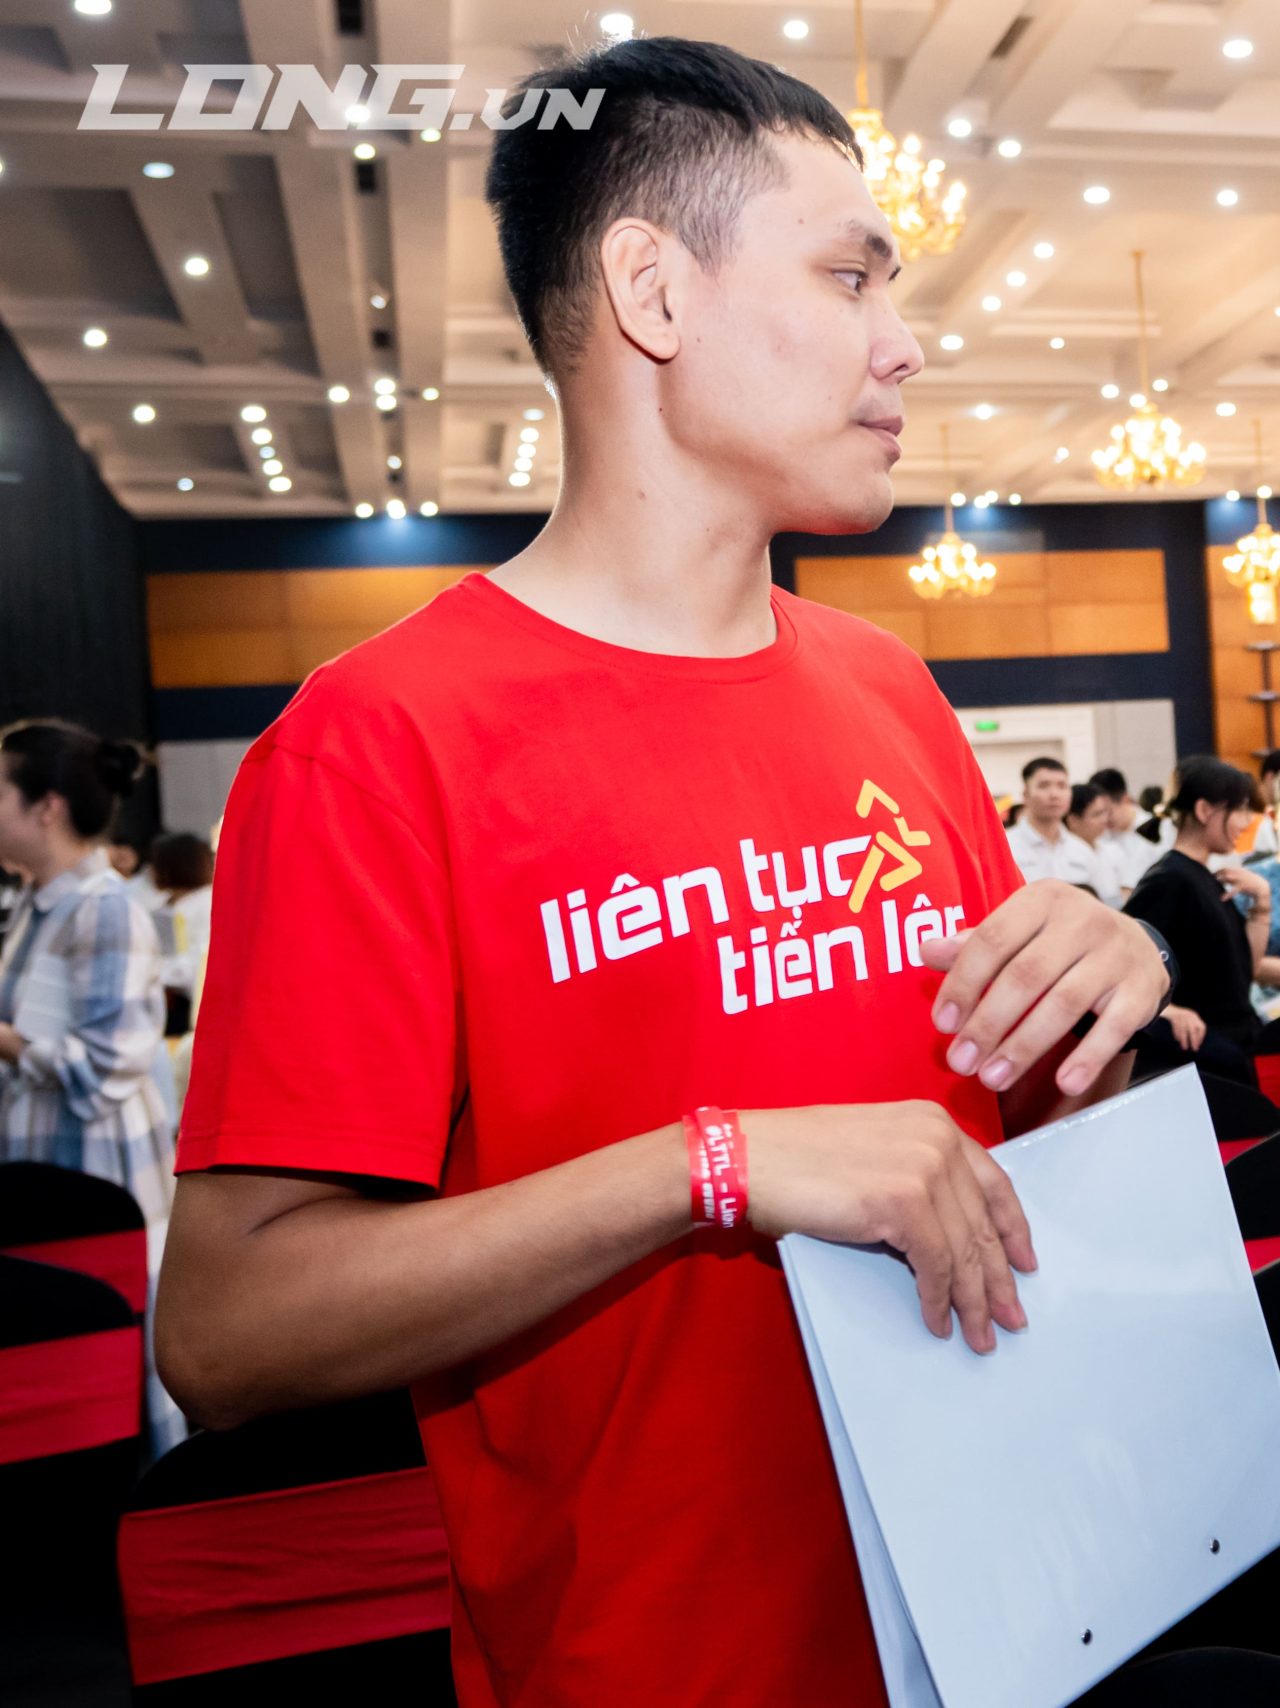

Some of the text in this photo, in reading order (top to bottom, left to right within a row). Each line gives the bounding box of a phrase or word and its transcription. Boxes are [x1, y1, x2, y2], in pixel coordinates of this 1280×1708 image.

[540, 834, 873, 983] liên tục
[717, 920, 868, 1015] tiến
